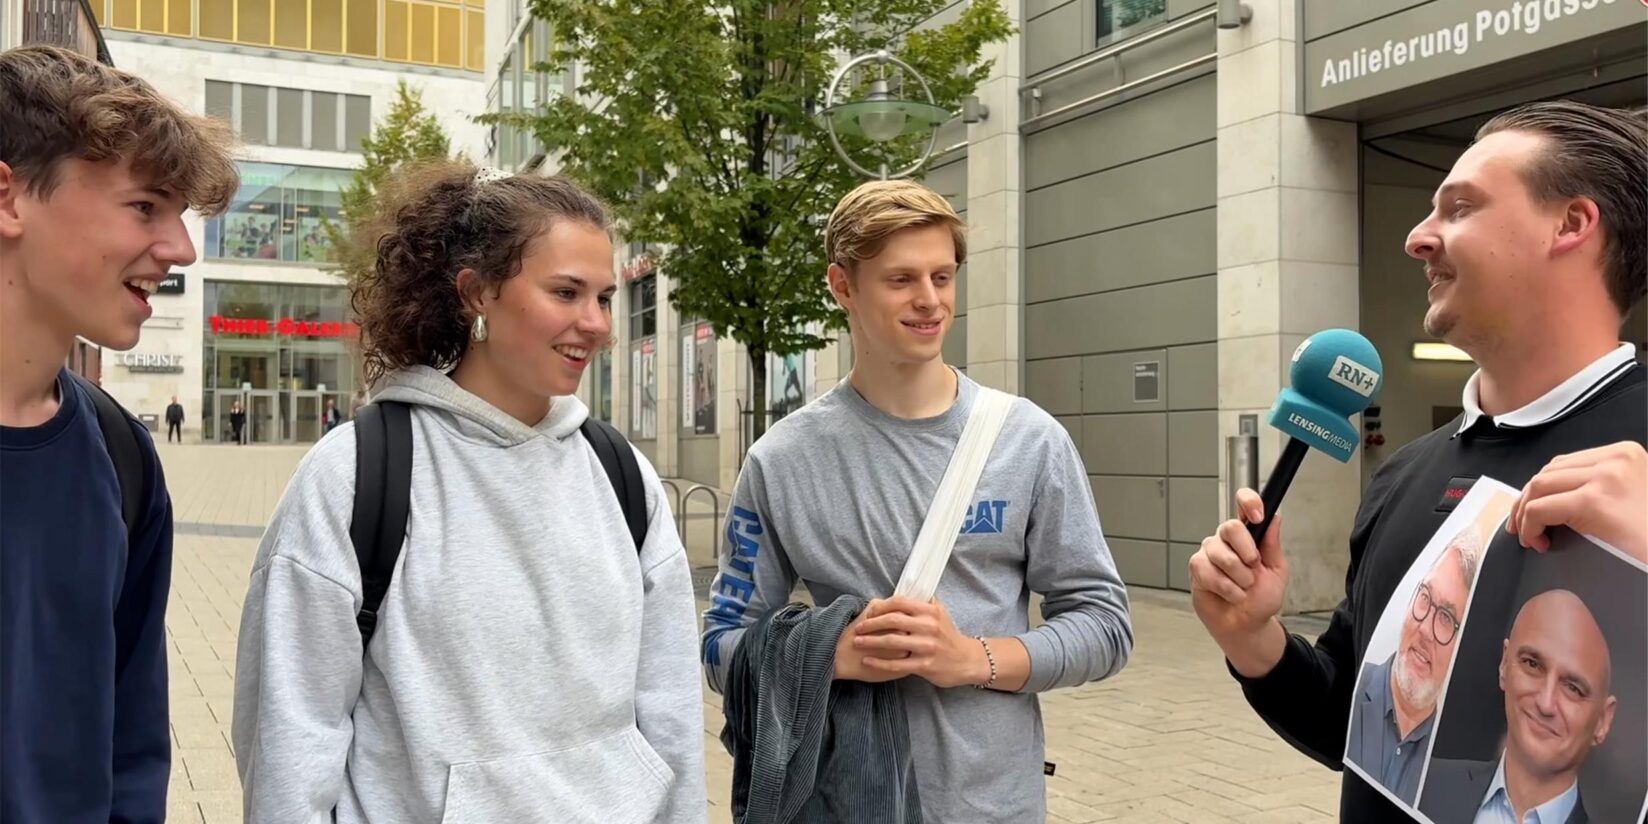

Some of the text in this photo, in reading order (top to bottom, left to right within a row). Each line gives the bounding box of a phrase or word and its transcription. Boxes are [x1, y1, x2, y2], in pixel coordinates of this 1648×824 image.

[1320, 0, 1616, 87] Anlieferung Potgas
[1335, 362, 1374, 390] RN+
[1443, 487, 1468, 498] HUG
